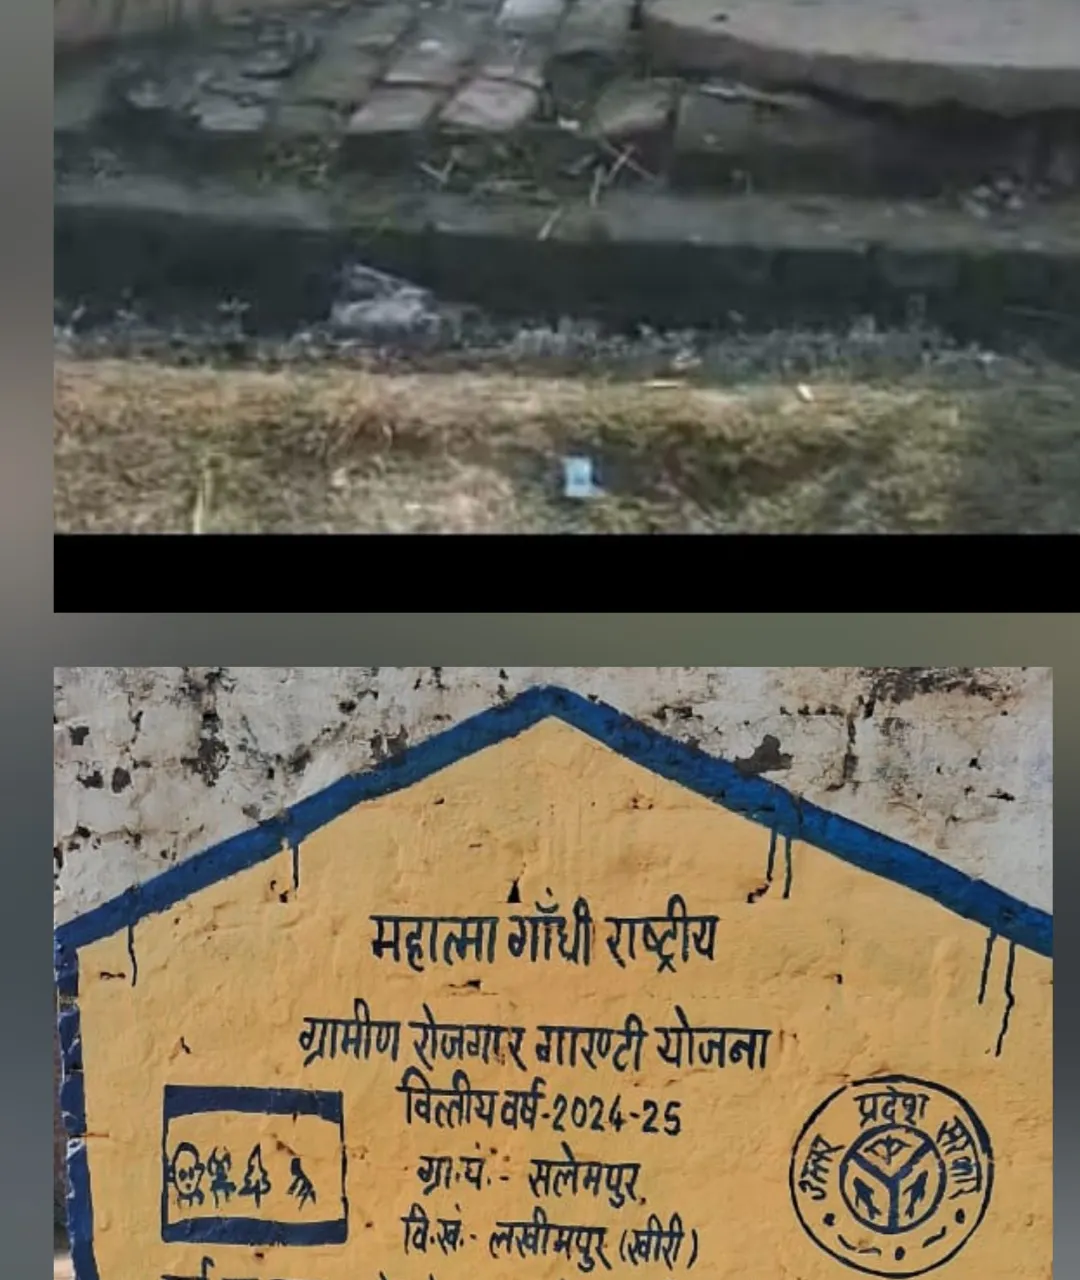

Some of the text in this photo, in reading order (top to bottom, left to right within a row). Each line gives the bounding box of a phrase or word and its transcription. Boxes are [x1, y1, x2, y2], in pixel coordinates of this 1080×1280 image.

[369, 888, 720, 973] महात्मा गाँधी राष्ट्रीय
[299, 998, 773, 1072] ग्रामीण रोजगार गारण्टी योजना
[396, 1067, 500, 1129] वित्तीय
[853, 1085, 930, 1128] प्रदेश
[528, 1140, 641, 1209] सलेमपुर
[489, 1206, 612, 1272] लखीमपुर
